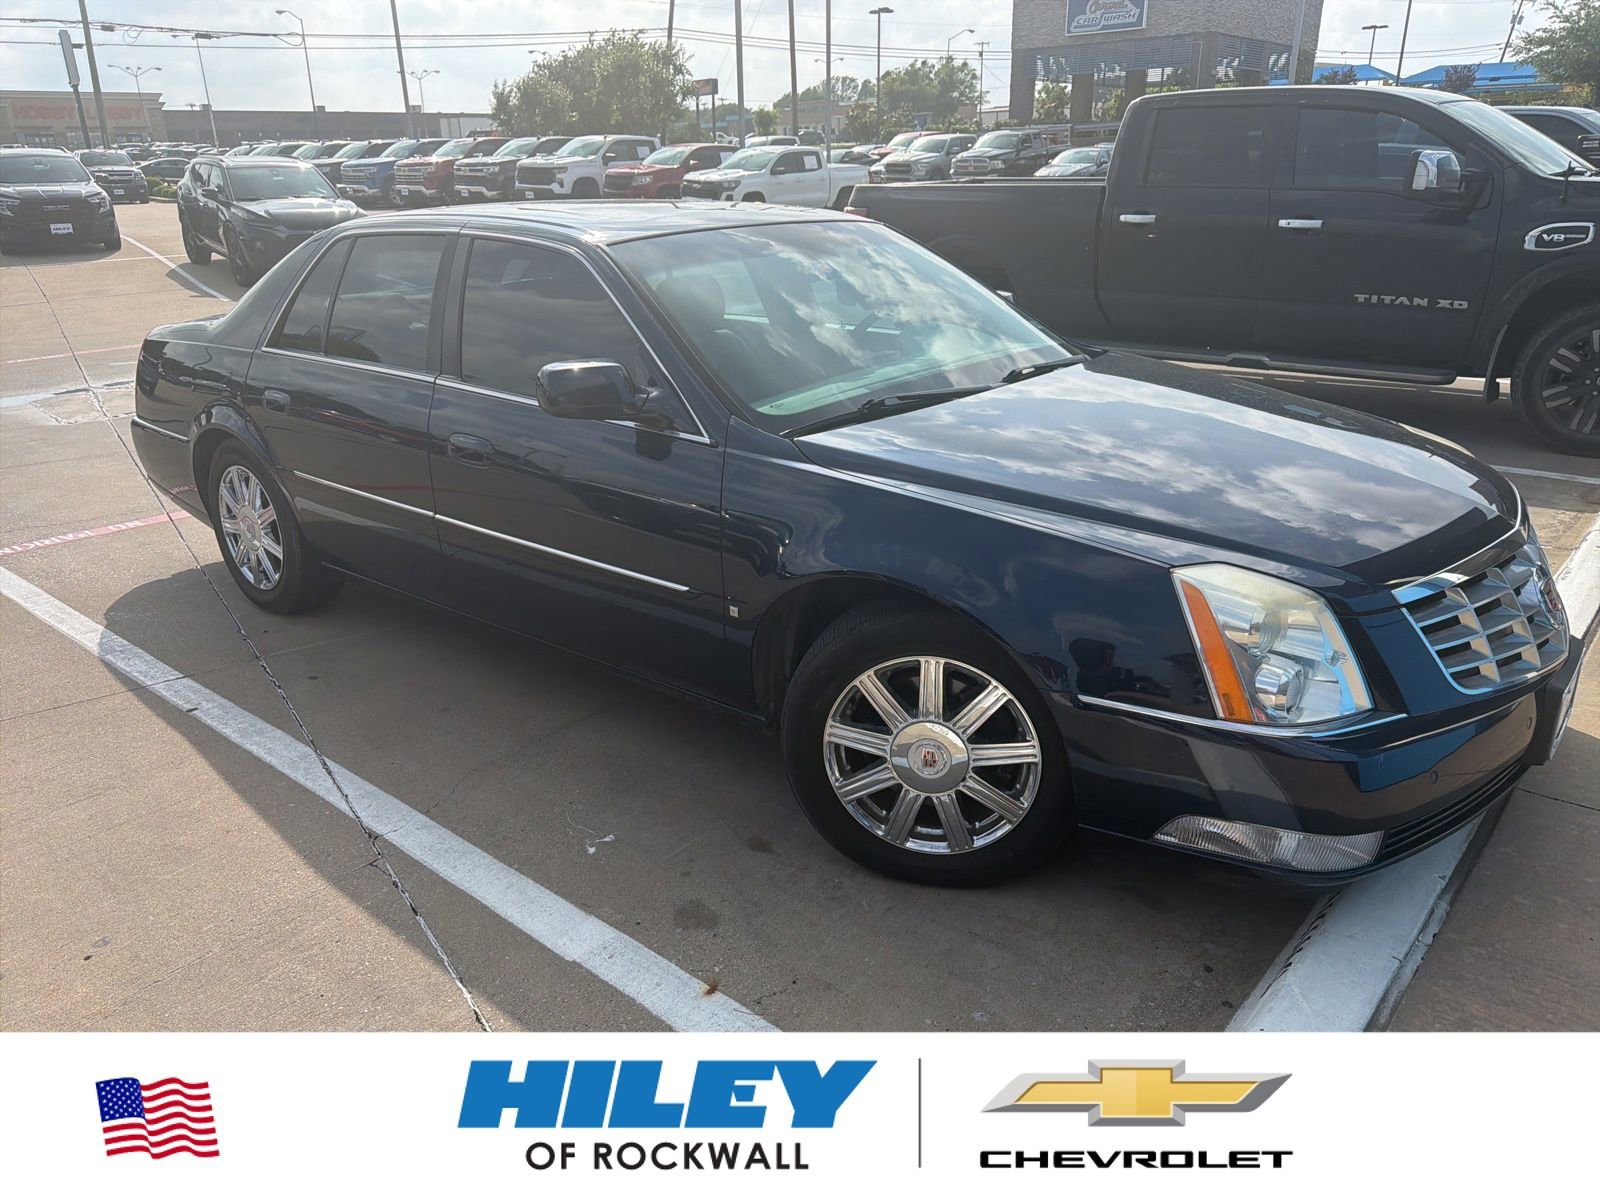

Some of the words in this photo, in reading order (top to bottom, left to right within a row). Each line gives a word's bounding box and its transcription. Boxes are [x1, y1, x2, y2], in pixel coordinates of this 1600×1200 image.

[1076, 16, 1099, 25] CAR
[1103, 12, 1137, 22] WASH
[86, 105, 144, 121] LBBY
[1541, 233, 1566, 242] V8
[1354, 294, 1428, 306] TITAN
[1435, 299, 1469, 309] XD
